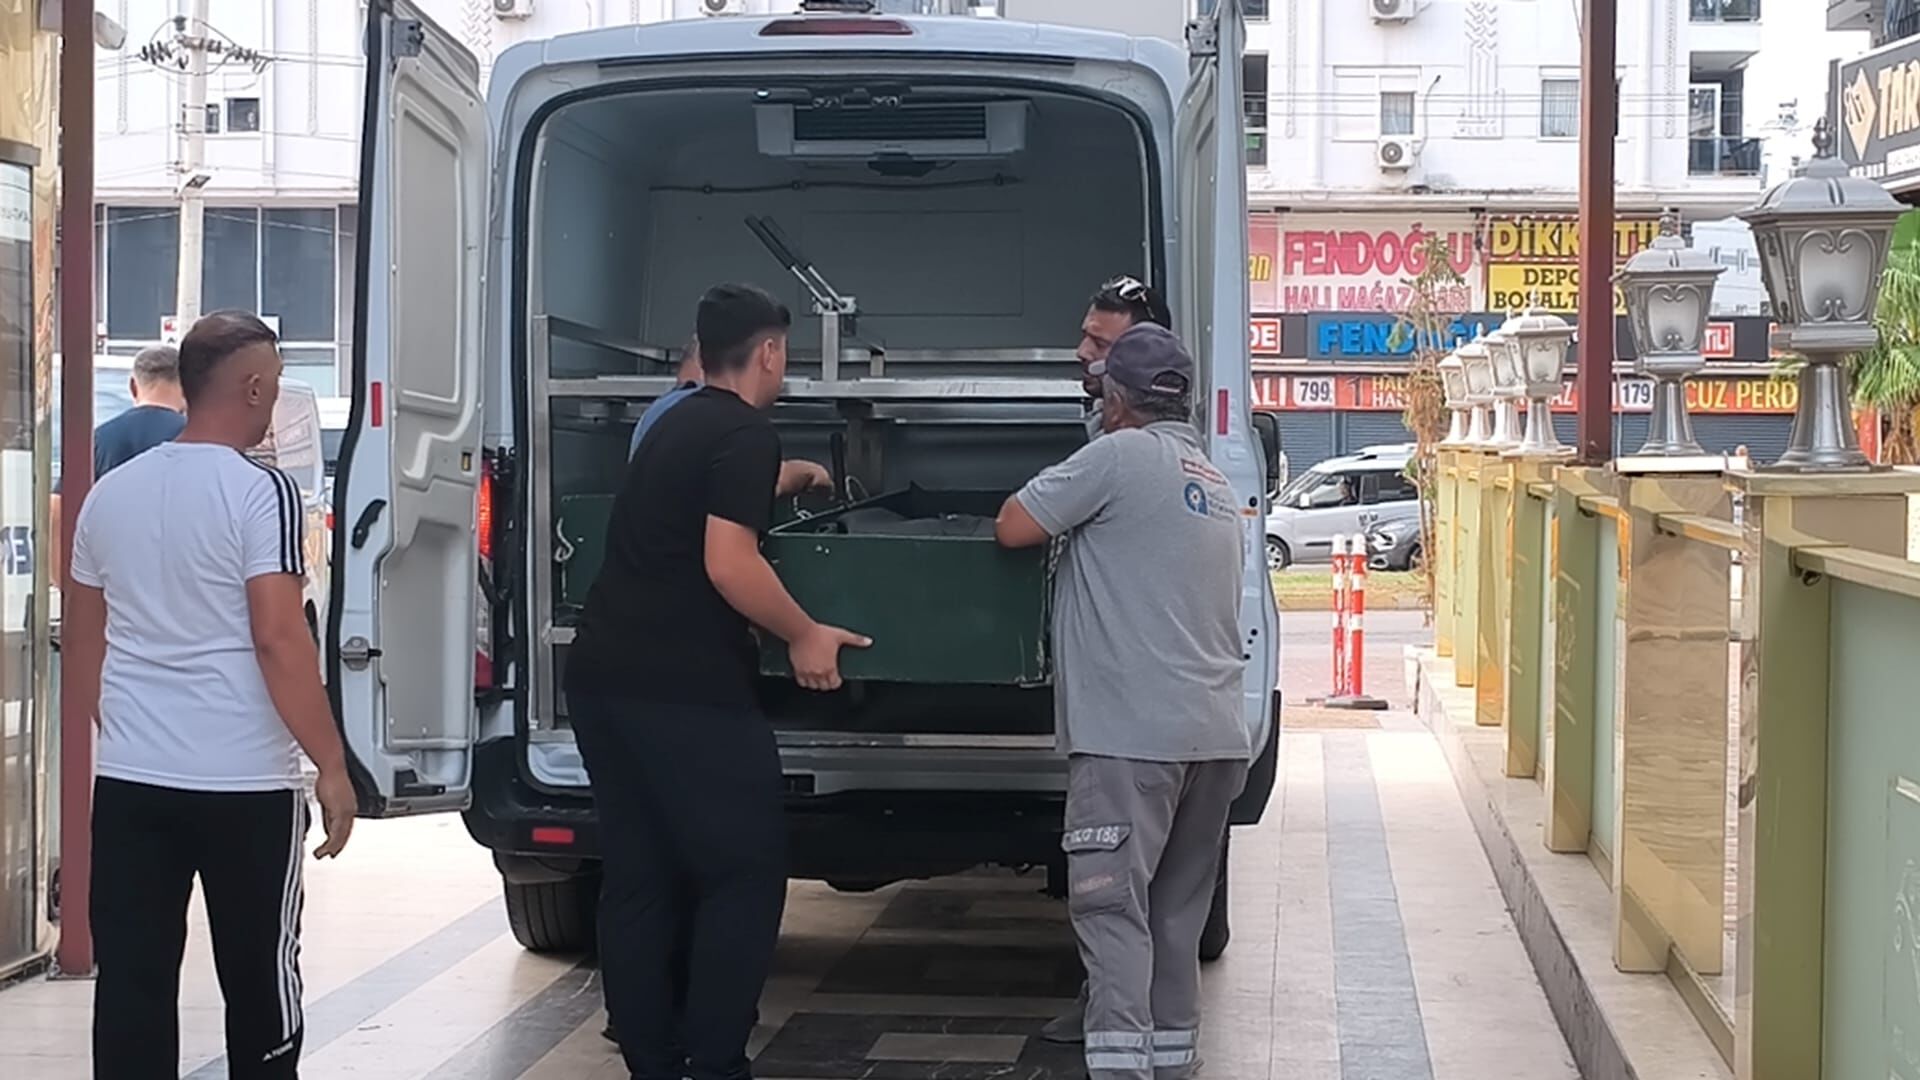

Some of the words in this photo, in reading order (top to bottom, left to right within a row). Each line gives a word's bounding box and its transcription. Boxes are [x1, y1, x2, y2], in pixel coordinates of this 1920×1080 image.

[1283, 222, 1473, 276] FENDOĞU
[1284, 285, 1332, 312] HALI
[1338, 280, 1473, 312] MAĞAZARI
[1300, 381, 1331, 403] 799
[1622, 383, 1651, 404] 179
